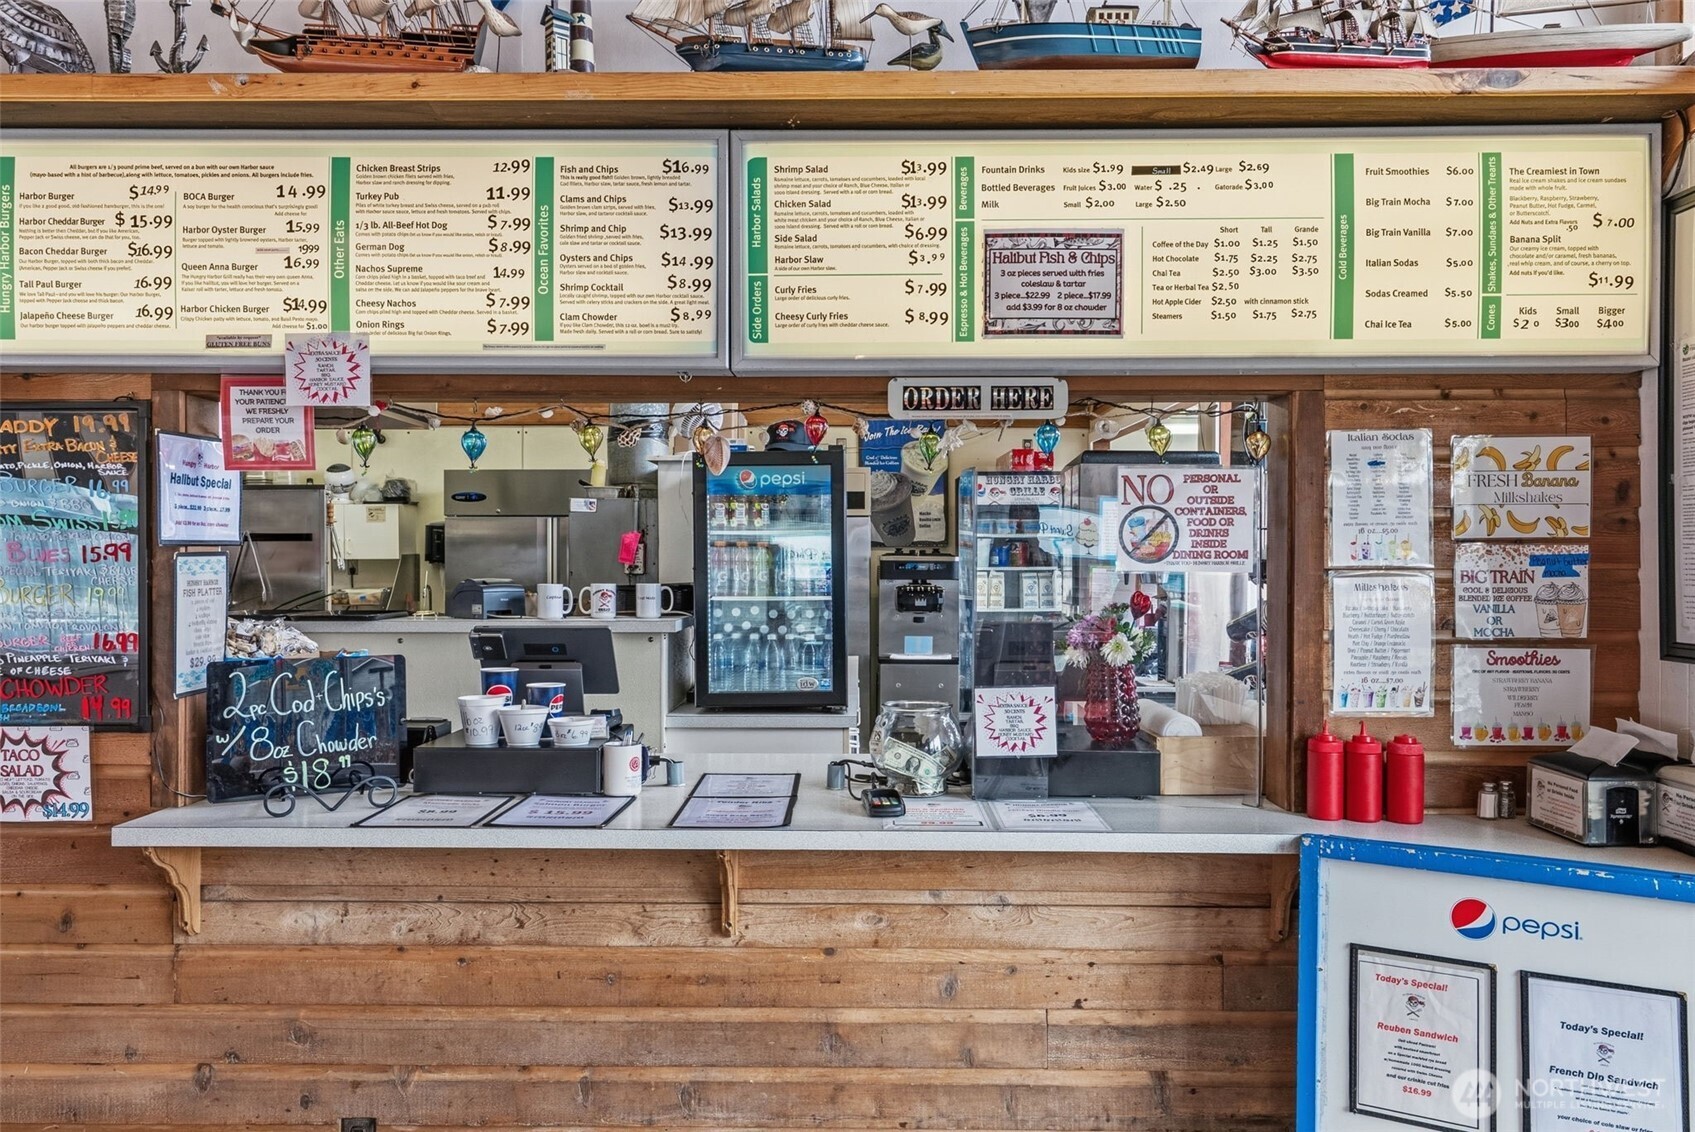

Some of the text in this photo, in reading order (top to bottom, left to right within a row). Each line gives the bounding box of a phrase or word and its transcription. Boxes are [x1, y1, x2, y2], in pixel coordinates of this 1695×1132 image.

[356, 164, 440, 174] Chicken Breast Strips
[493, 159, 530, 174] 12.99
[982, 166, 1016, 174] Fountain
[1447, 166, 1474, 175] $6.00
[1526, 167, 1567, 175] Creamiest
[1579, 167, 1599, 175] Town
[959, 166, 969, 210] Beverages
[208, 193, 234, 202] Burger
[774, 200, 831, 208] Chicken Salad
[752, 178, 762, 248] Harbor Salads
[286, 220, 320, 233] 15.99
[905, 225, 947, 241] $6.99
[389, 243, 404, 252] Dog
[1196, 241, 1208, 249] Day
[1214, 238, 1240, 248] $1.00
[1253, 238, 1278, 248] $1.25
[1338, 214, 1347, 280] Cold Beverages
[0, 184, 12, 313] Hungry Harbor Burgers
[81, 247, 107, 257] Burger
[128, 241, 172, 259] $16.99
[334, 220, 344, 278] Other Eats
[538, 204, 549, 296] Ocean Favorites
[992, 251, 1116, 267] Halibut Fish & Chips
[1366, 259, 1391, 267] Italian
[182, 263, 207, 271] Queen
[232, 263, 258, 272] Burger
[1018, 270, 1041, 278] pieces
[19, 280, 82, 290] Tall Paul Burger
[775, 286, 796, 295] Curly
[136, 305, 173, 321] 16.99
[243, 305, 269, 314] Burger
[1519, 307, 1537, 315] Kids
[1556, 307, 1579, 315] Small
[1599, 306, 1625, 316] Bigger
[20, 312, 54, 321] Jalapeño
[88, 312, 113, 321] Burger
[356, 320, 404, 330] Onion Rings
[903, 386, 1053, 410] ORDER HERE
[73, 412, 130, 433] 19.99
[1347, 432, 1414, 442] Italian Sodas
[170, 472, 232, 490] Halibut Special
[760, 472, 806, 488] pepsi
[1183, 474, 1241, 484] PERSONAL
[1468, 473, 1579, 488] FRESH Banana
[1121, 474, 1175, 505] NO
[1203, 485, 1219, 494] OR
[1187, 496, 1234, 505] OUTSIDE
[1494, 491, 1562, 504] Milkshakes
[1174, 507, 1247, 516] CONTAINERS,
[1187, 518, 1234, 527] FOOD OR
[1188, 528, 1229, 538] DRINKS
[1190, 540, 1227, 548] INSIDE
[82, 543, 131, 564] 15.99
[1172, 550, 1248, 560] DINING ROOM!
[183, 587, 223, 597] FISH PLATTER
[1473, 604, 1515, 613] VANILLA
[1487, 616, 1502, 625] OR
[1474, 628, 1514, 637] MOCHA
[6, 652, 116, 664] PINEAPPLE TERIYAKI
[1487, 650, 1561, 666] Smoothies
[25, 666, 72, 676] CHEESE
[0, 675, 109, 700] CHOWDER
[296, 720, 377, 757] Chowder
[1, 749, 40, 761] TACO
[0, 765, 44, 777] SALAD
[43, 802, 89, 819] $14.99
[1502, 915, 1579, 940] pepsi
[1376, 974, 1448, 991] Today's Special!
[1377, 1022, 1458, 1043] Reuben Sandwich
[1559, 1021, 1644, 1041] Today's Special!
[1549, 1065, 1659, 1090] French Dip Sandwich
[1402, 1086, 1432, 1097] $16.99
